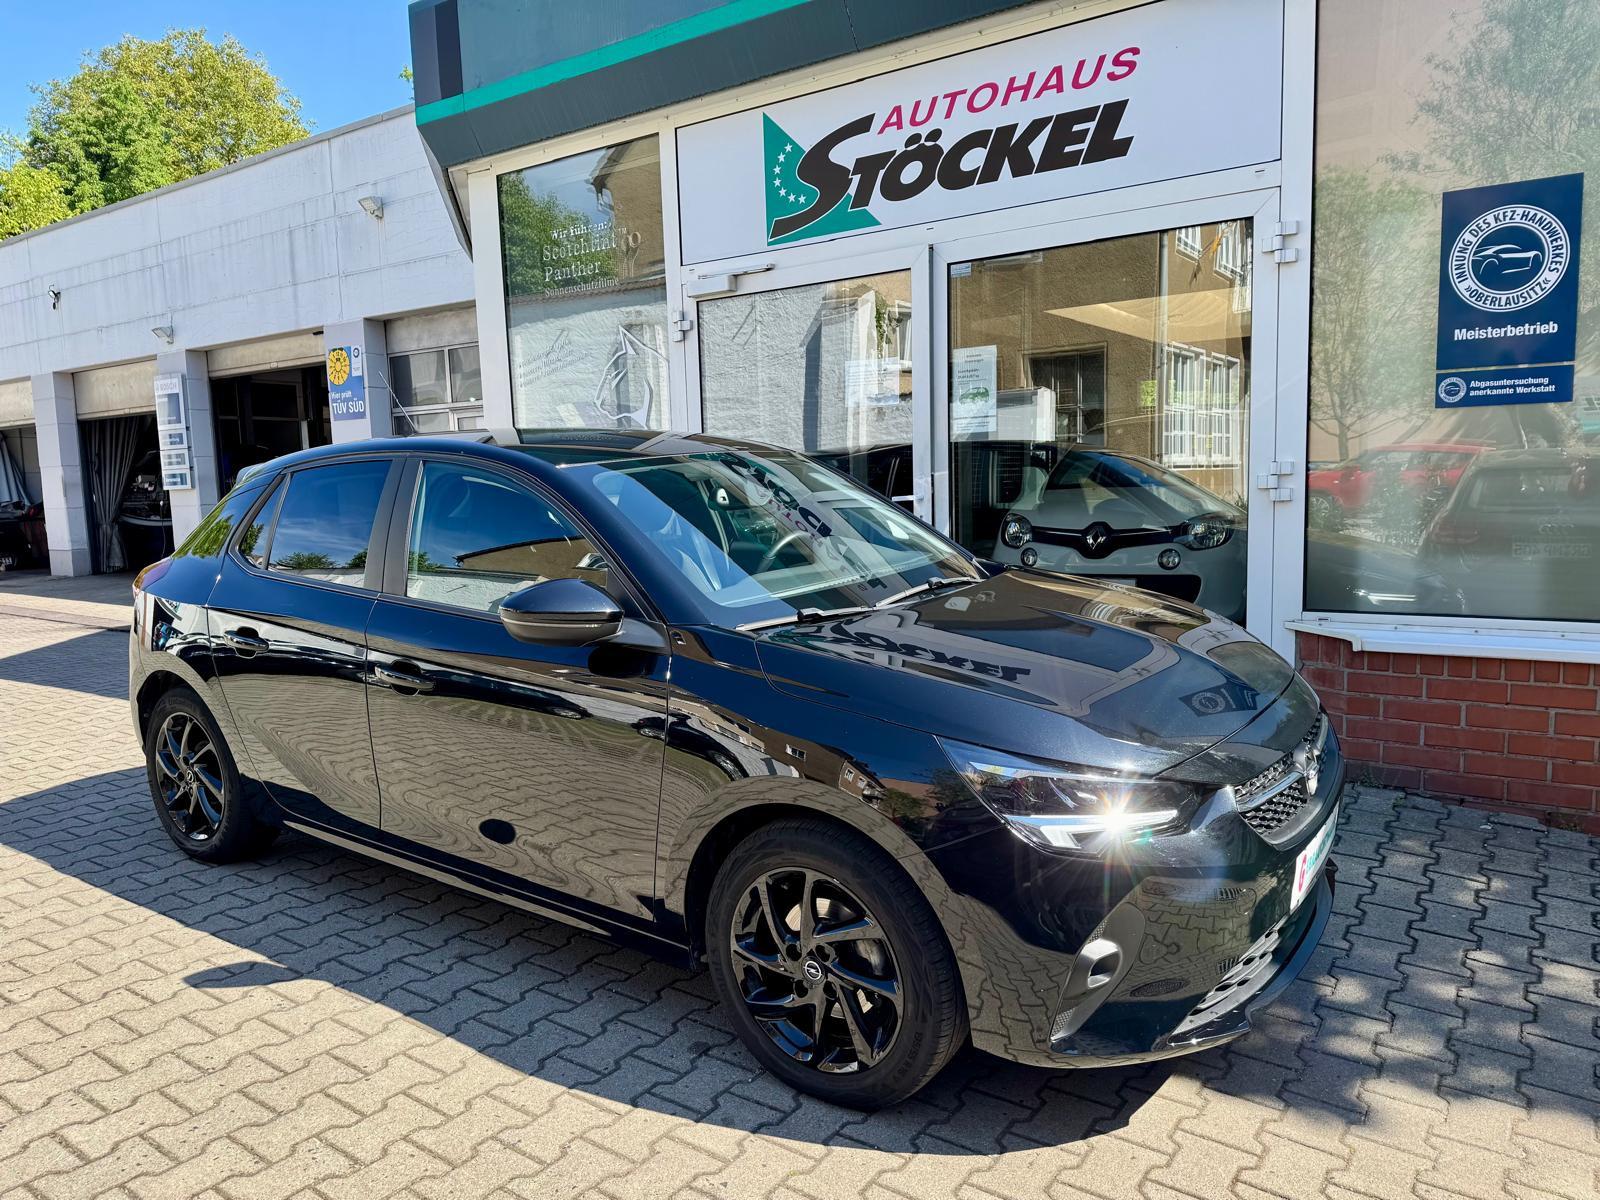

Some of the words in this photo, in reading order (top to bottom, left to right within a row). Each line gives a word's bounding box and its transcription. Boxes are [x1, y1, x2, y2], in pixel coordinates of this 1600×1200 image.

[876, 46, 1141, 135] AUTOHAUS
[768, 98, 1134, 240] STÖCKEL
[550, 228, 568, 240] Wir
[1454, 238, 1473, 284] INNUNG
[1469, 218, 1492, 238] DES
[1493, 209, 1564, 274] KFZ-HANDWERKES
[544, 261, 601, 282] Panther
[1454, 321, 1559, 341] Meisterbetrieb
[1469, 387, 1514, 396] anerkannte
[1516, 384, 1556, 394] Werkstatt
[1470, 376, 1549, 389] Abgasuntersuchung
[332, 400, 347, 415] TÜV
[349, 398, 365, 413] SÜD
